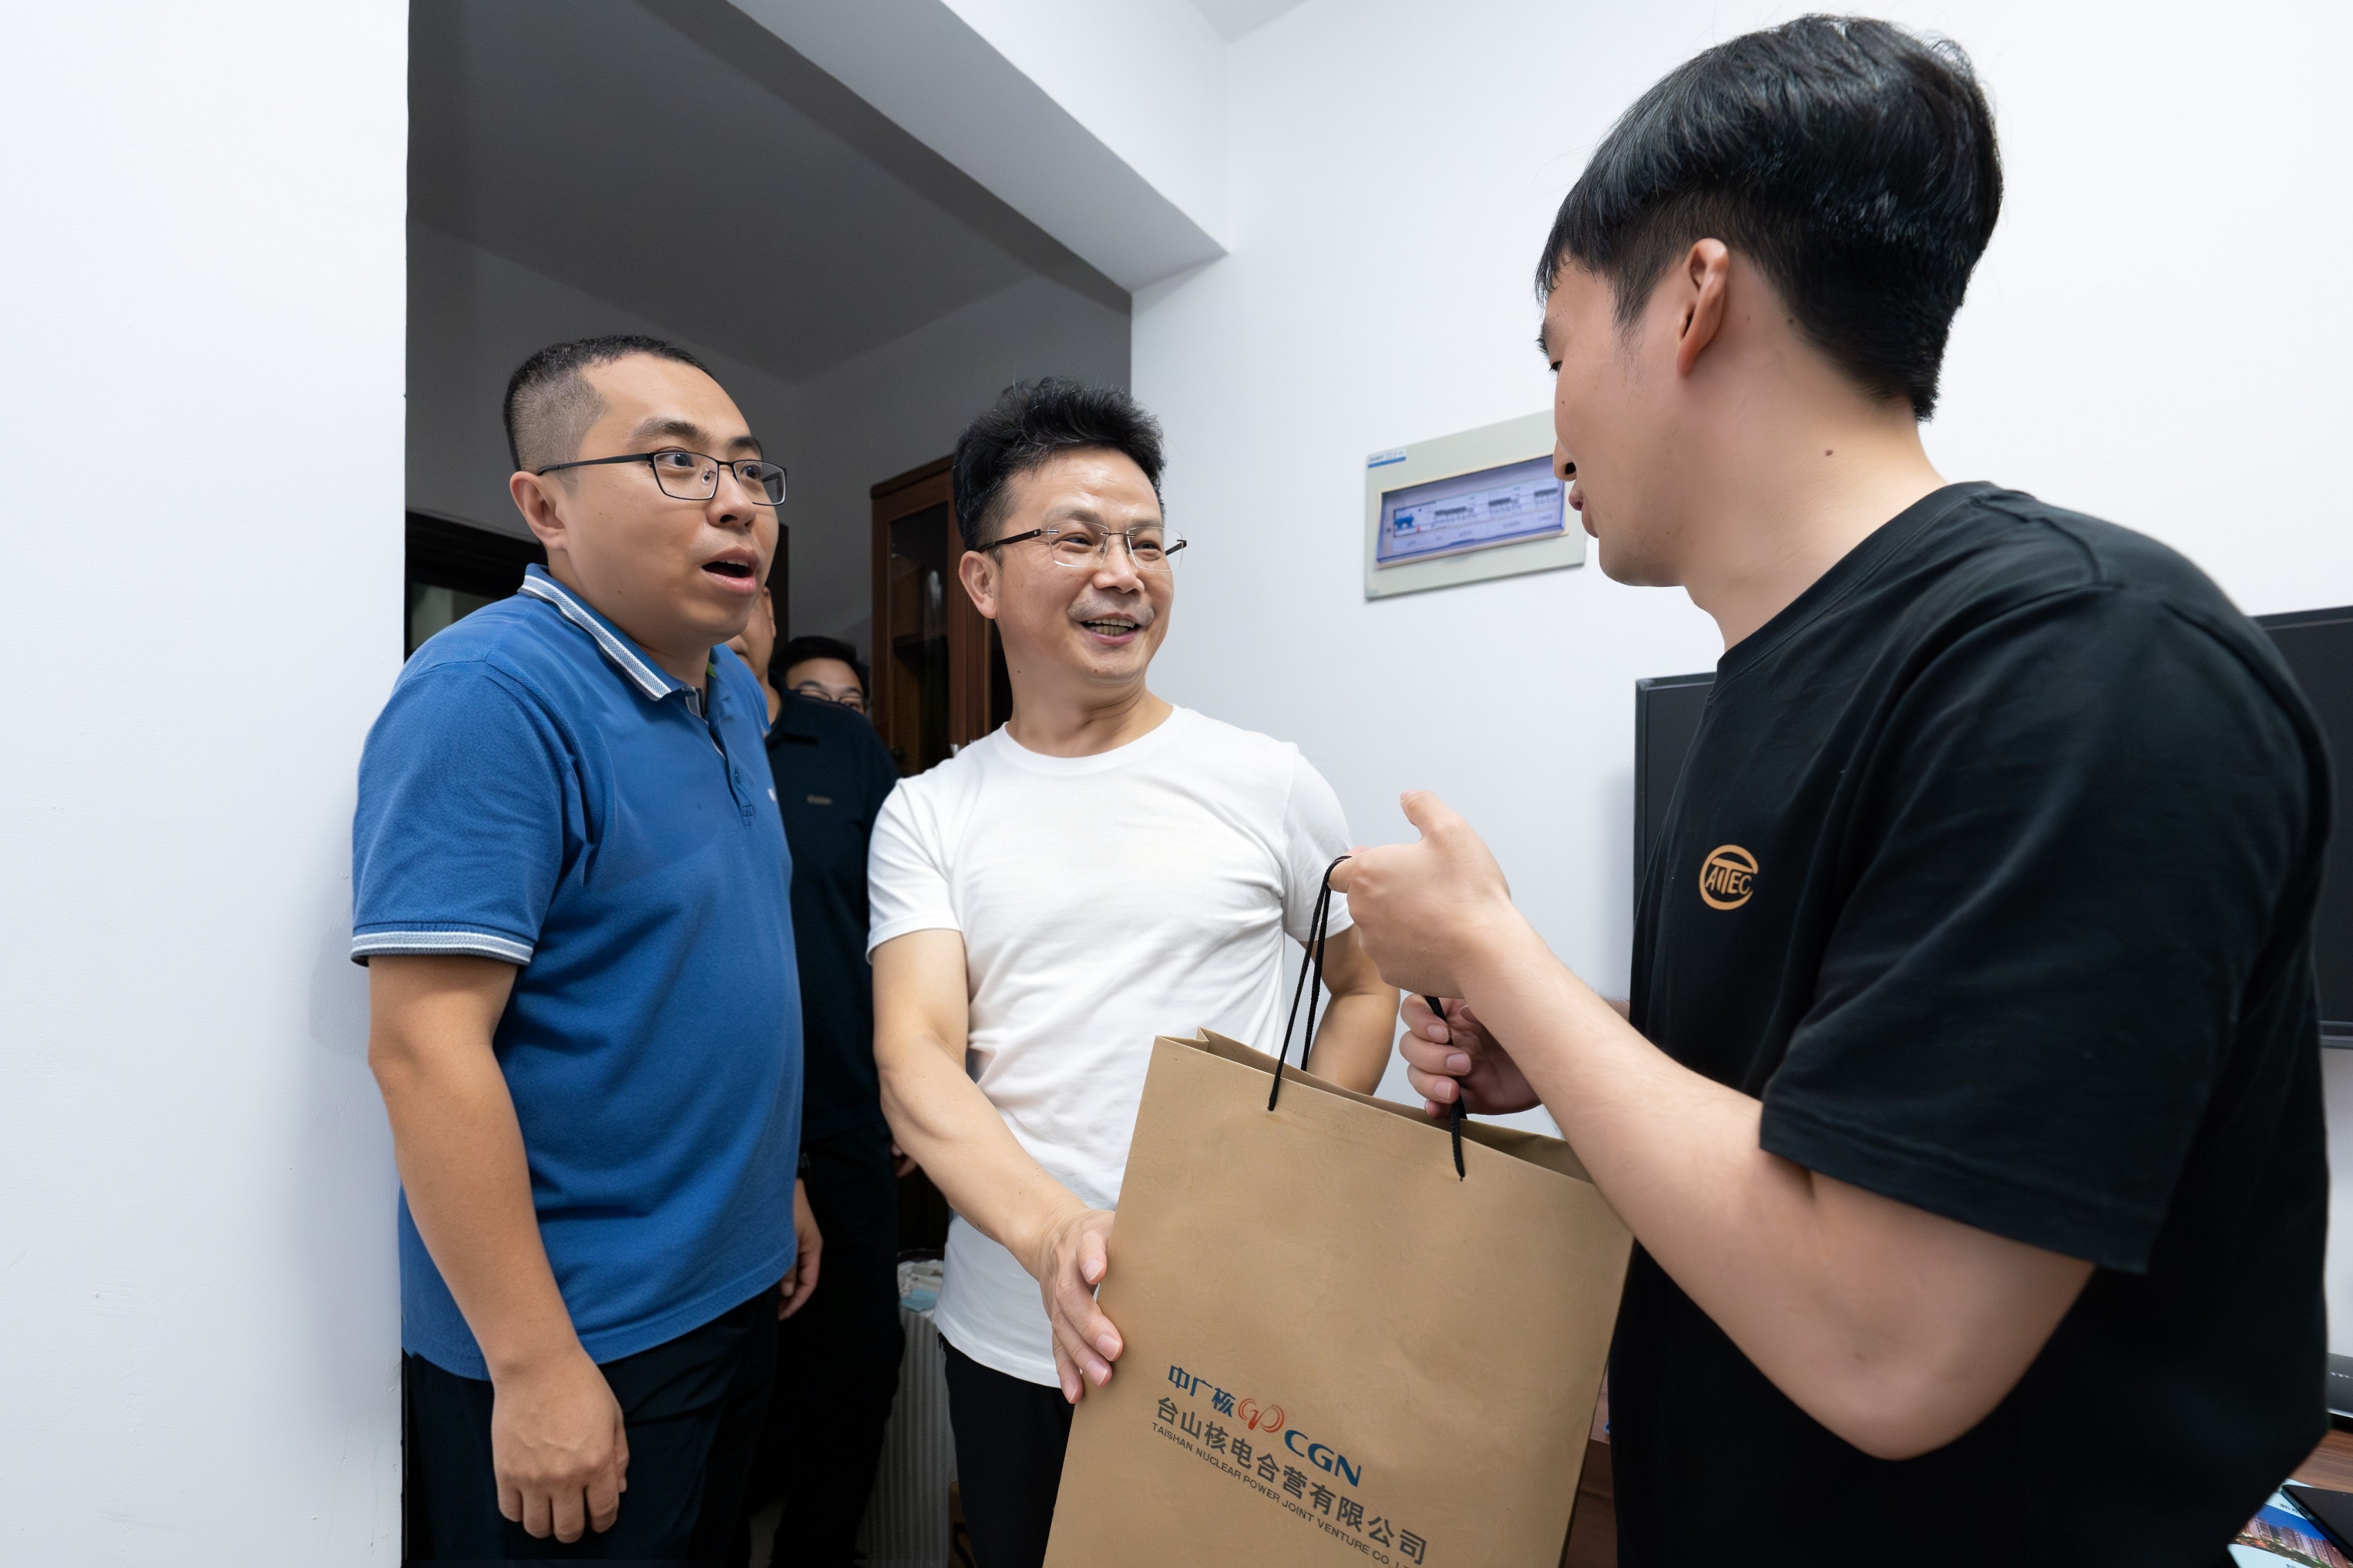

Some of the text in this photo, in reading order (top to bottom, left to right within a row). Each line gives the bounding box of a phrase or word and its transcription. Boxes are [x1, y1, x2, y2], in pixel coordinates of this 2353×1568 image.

[1152, 1422, 1193, 1452] TAISHAN
[1195, 1447, 1242, 1480] NUCLEAR
[1243, 1475, 1280, 1503] POWER
[1282, 1499, 1315, 1522] JOINT
[1317, 1518, 1371, 1556] VENTURE
[1157, 1397, 1427, 1565] 台山核电合营有限公司
[1168, 1365, 1361, 1488] 中广核 CGN
